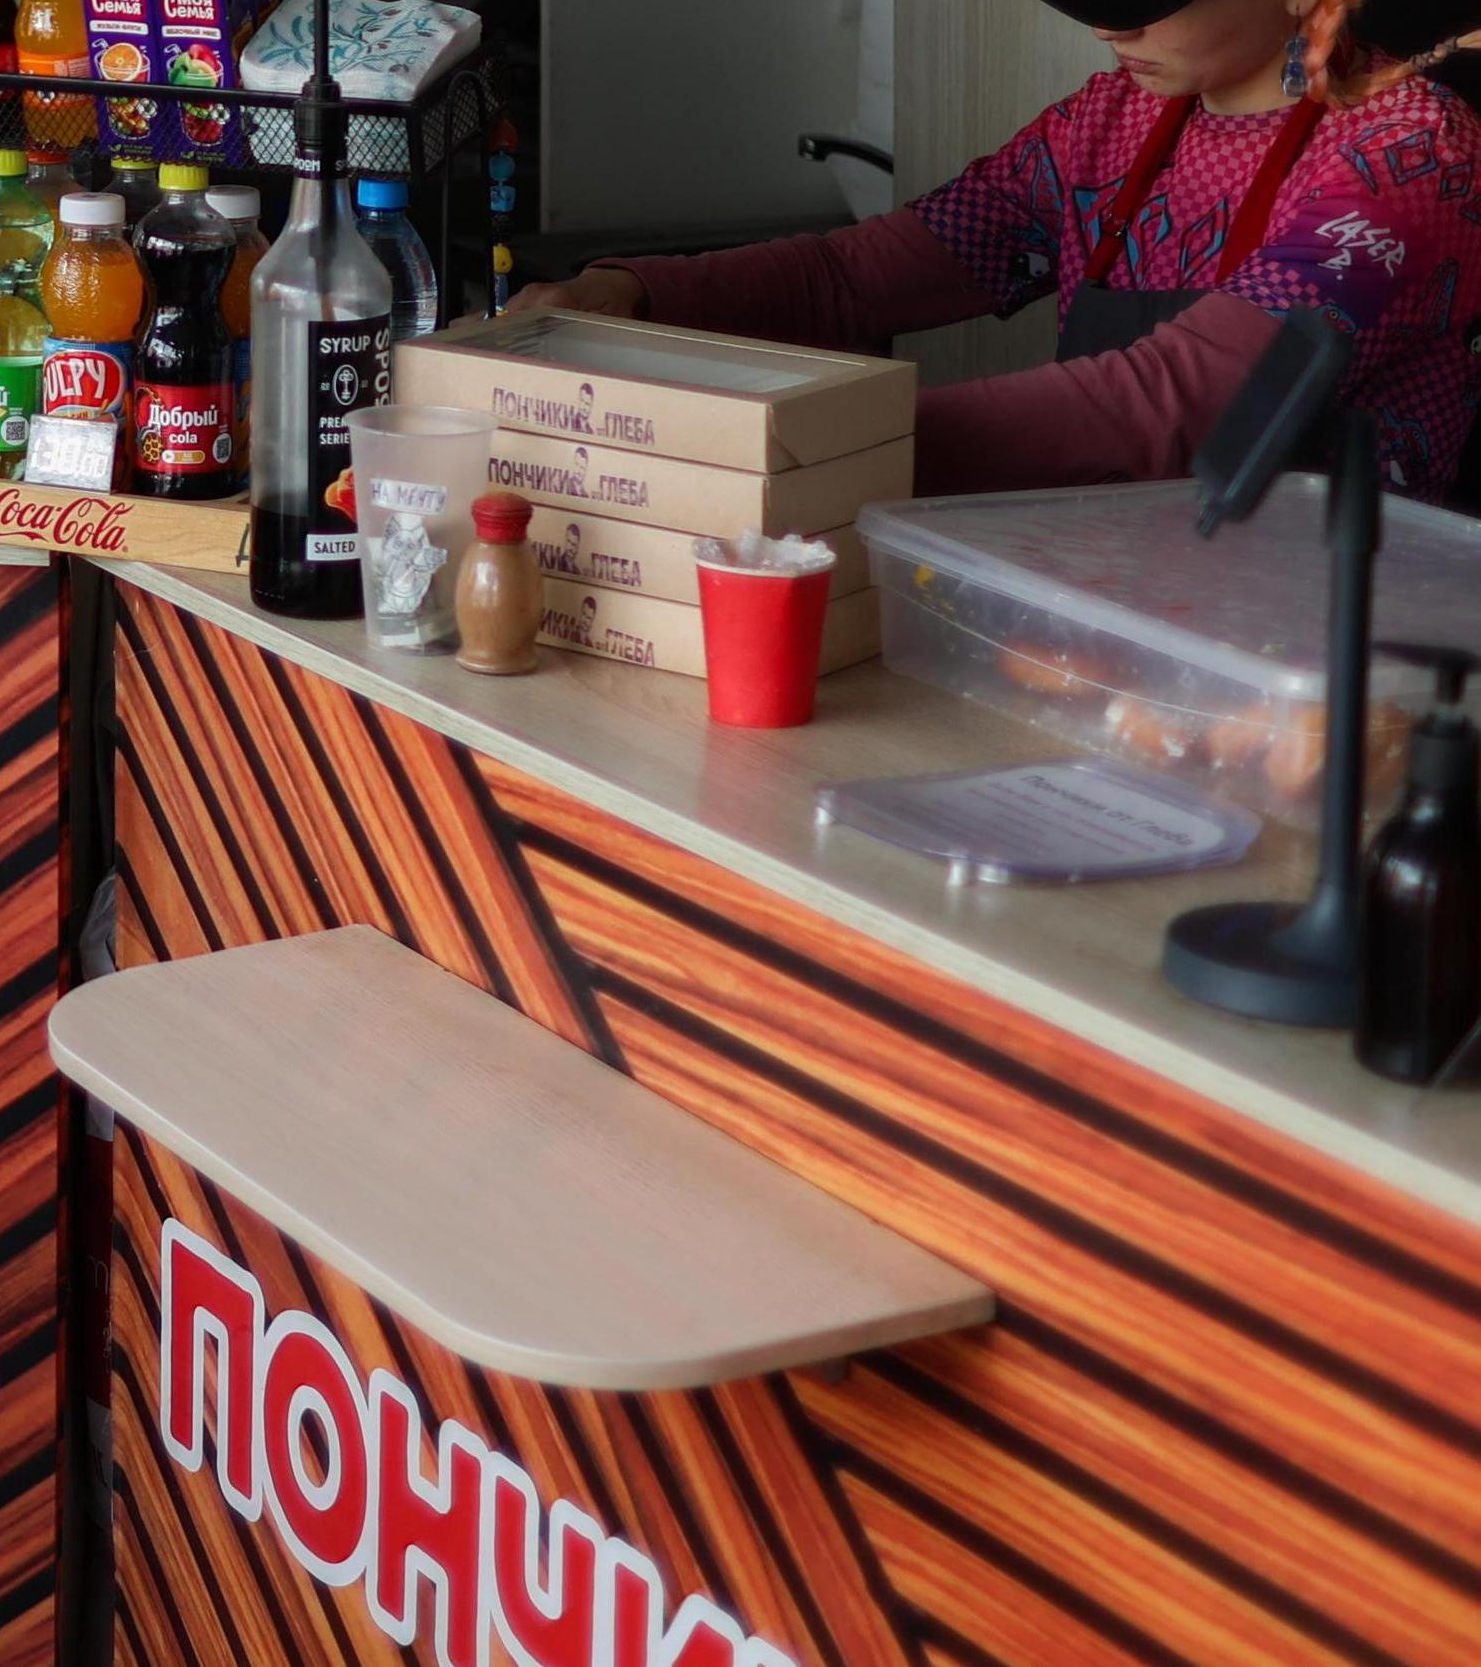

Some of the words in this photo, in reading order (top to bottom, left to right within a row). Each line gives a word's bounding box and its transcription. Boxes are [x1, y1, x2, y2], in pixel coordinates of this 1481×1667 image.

[1315, 210, 1405, 278] LASER
[319, 336, 370, 354] SYRUP
[44, 357, 106, 402] ULPY
[147, 403, 219, 431] Добрый
[492, 387, 575, 431] ПОНЧИКИ
[604, 411, 655, 446] ГЛЕБА
[169, 431, 198, 444] cola
[488, 457, 572, 496] ПОНЧИКИ
[599, 474, 649, 507] ГЛЕБА
[314, 540, 355, 553] SALTED
[591, 552, 642, 587] ГЛЕБА
[605, 628, 655, 666] ГЛЕБА
[160, 1219, 802, 1667] ПОНЧ
